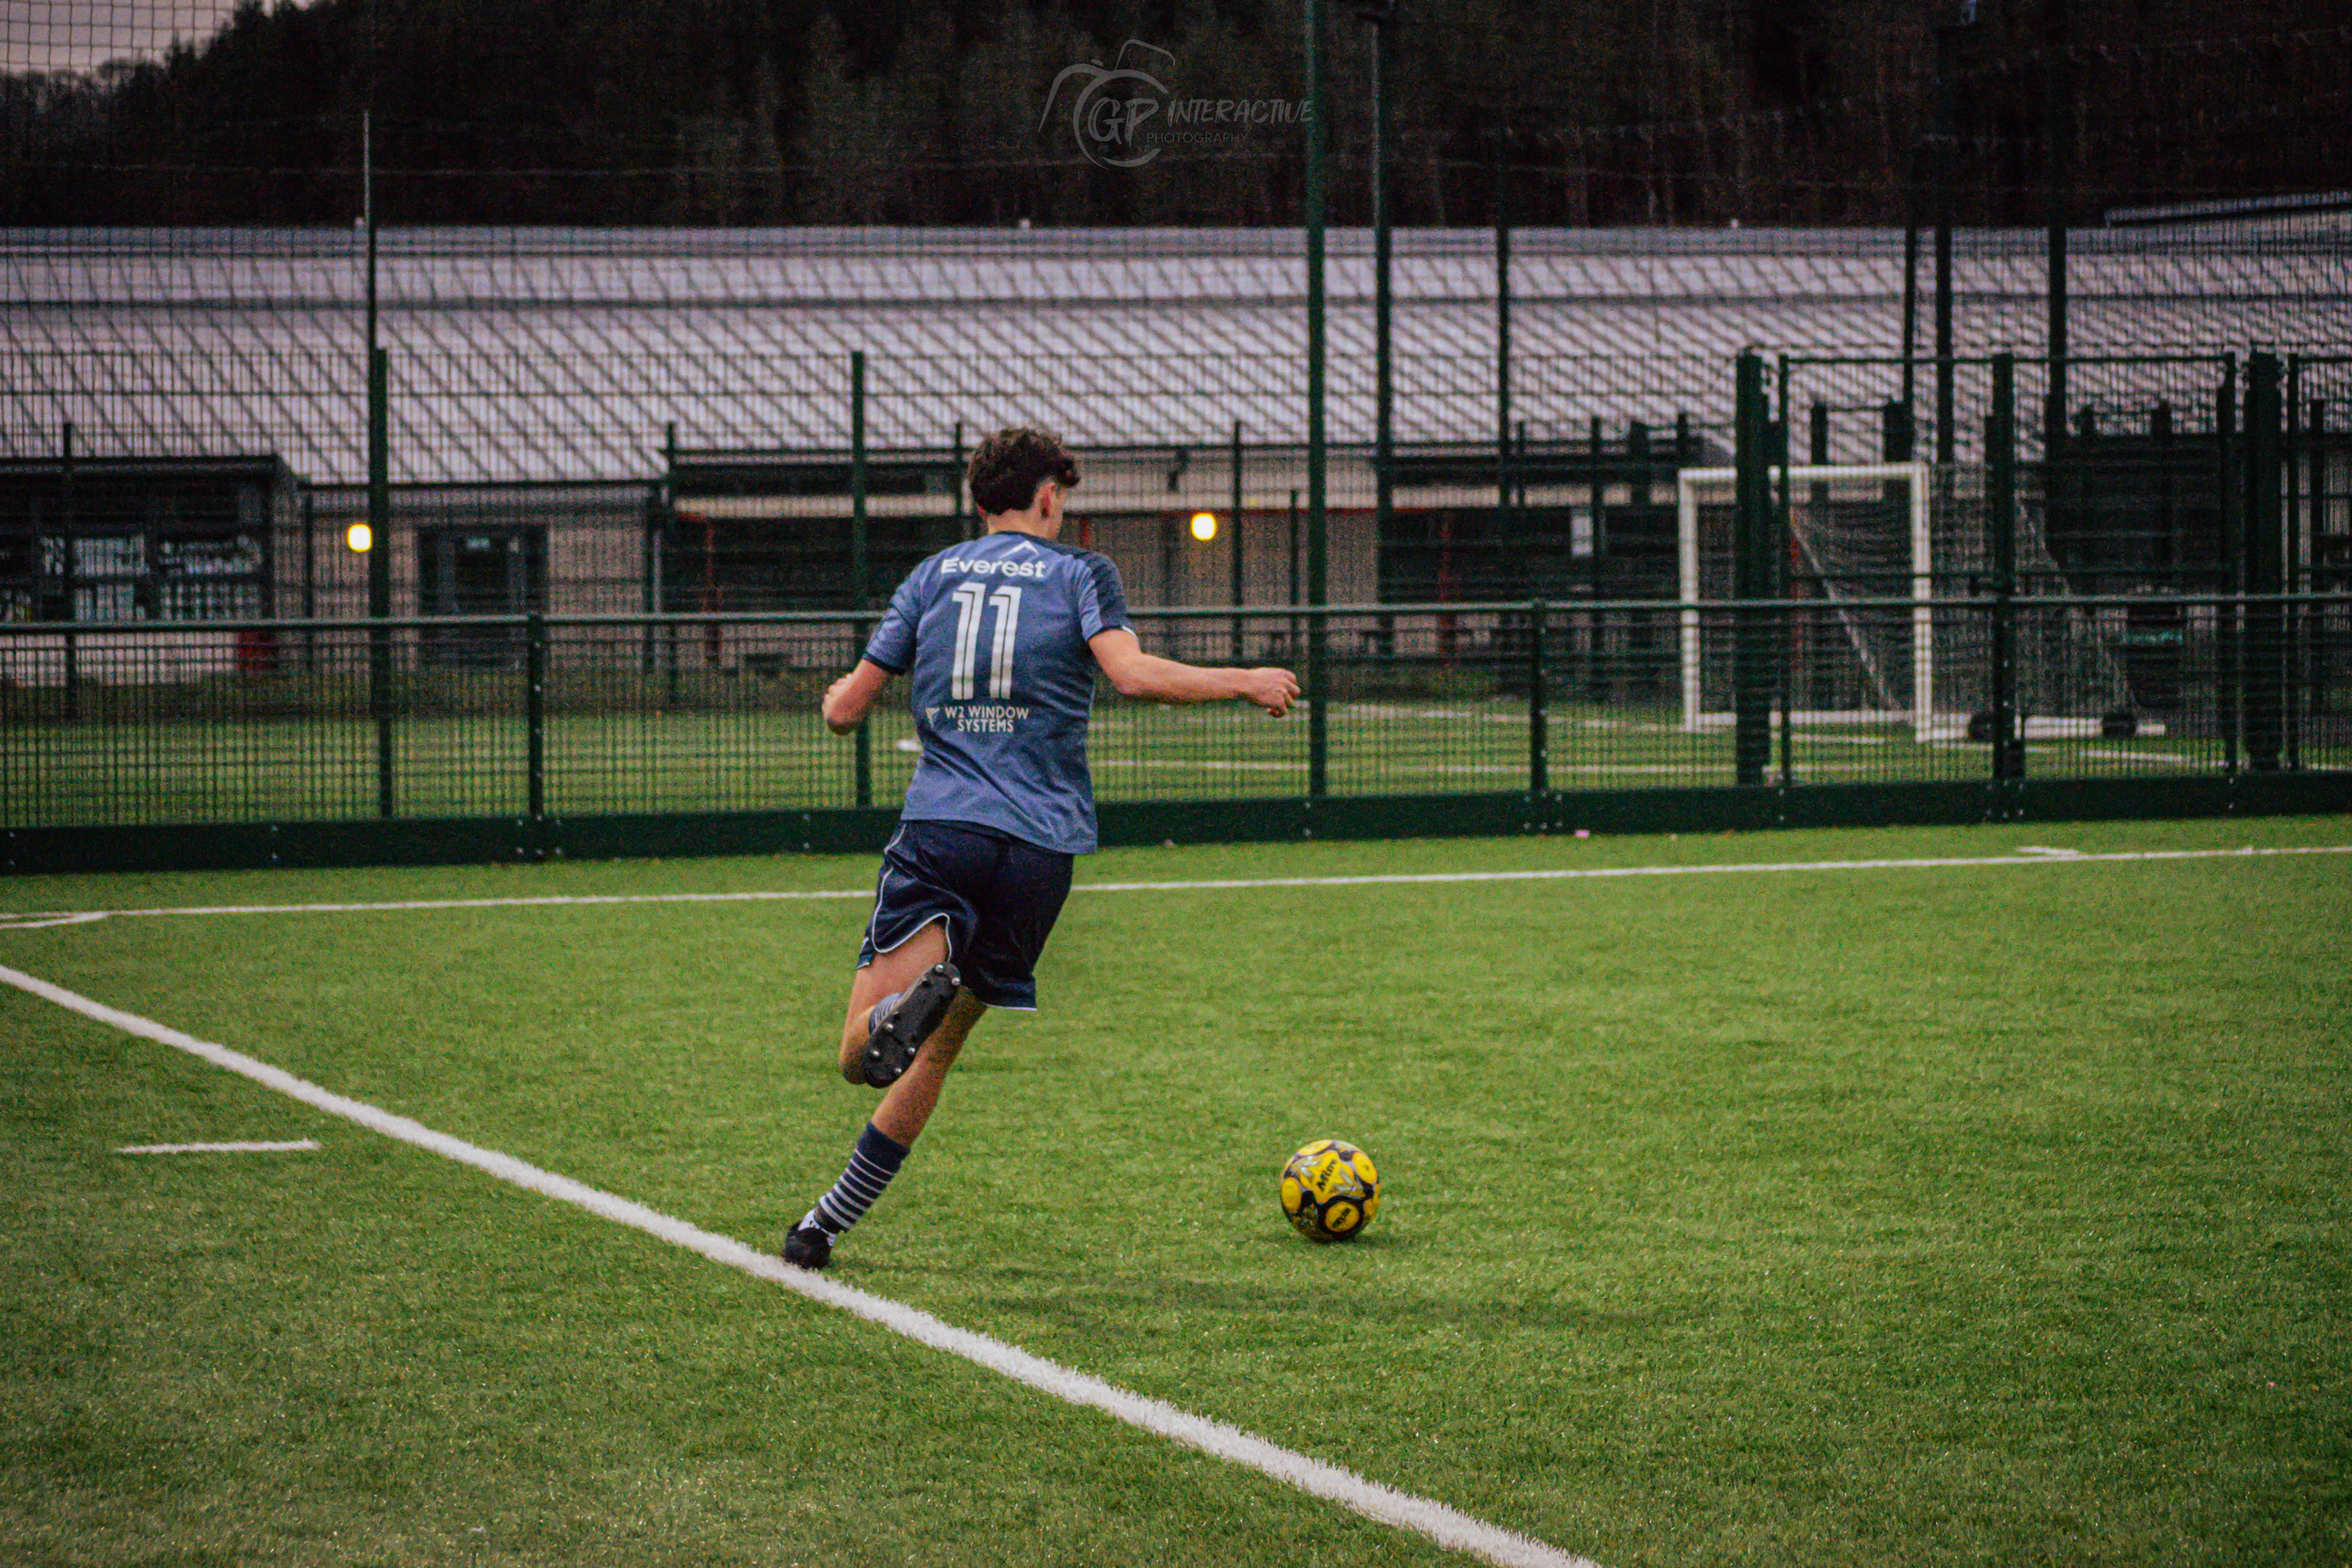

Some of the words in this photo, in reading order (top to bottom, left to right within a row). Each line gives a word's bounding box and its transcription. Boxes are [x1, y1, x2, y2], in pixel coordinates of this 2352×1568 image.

[941, 557, 1046, 578] Everest
[951, 581, 1022, 700] 11
[968, 705, 1029, 720] WINDOW
[957, 719, 1014, 732] SYSTEMS
